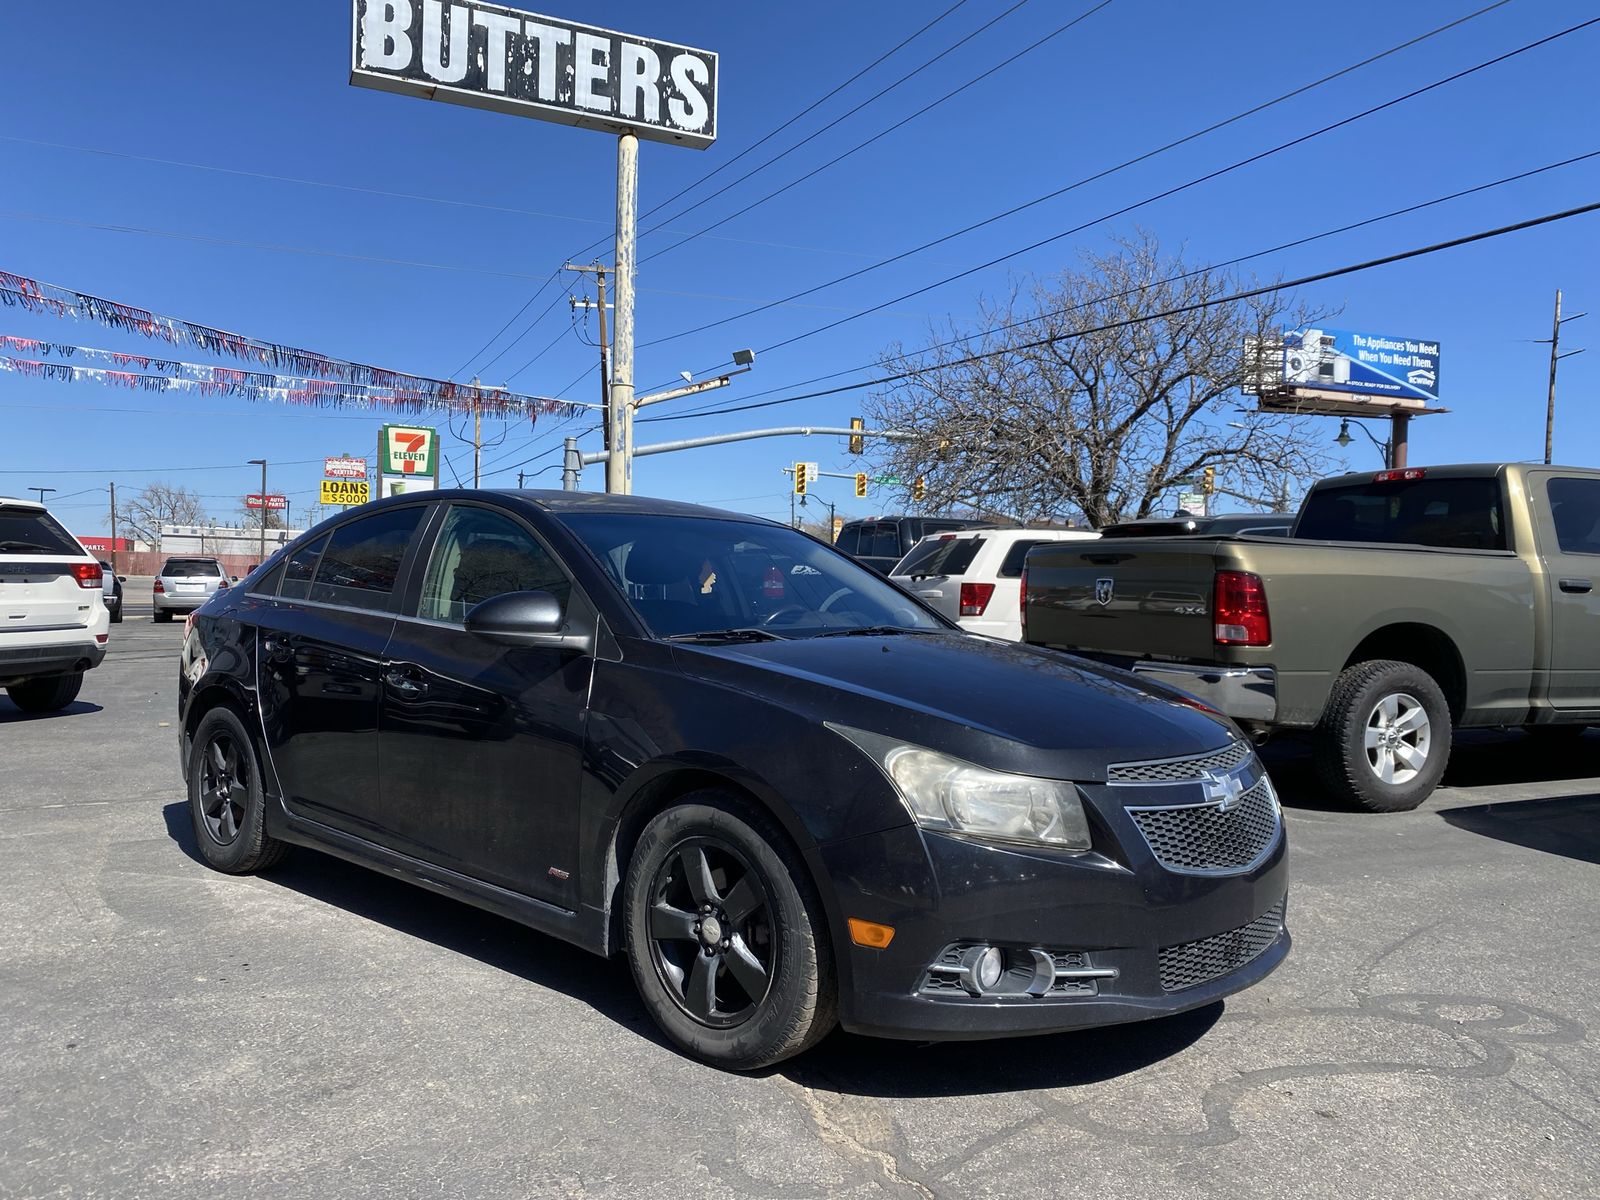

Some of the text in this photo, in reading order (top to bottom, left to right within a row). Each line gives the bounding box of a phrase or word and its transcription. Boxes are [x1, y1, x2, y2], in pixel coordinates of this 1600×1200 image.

[361, 0, 709, 130] BUTTERS
[1353, 335, 1439, 356] The Appliances You Need,
[1359, 350, 1434, 368] When You Need Them.
[323, 482, 368, 494] LOANS
